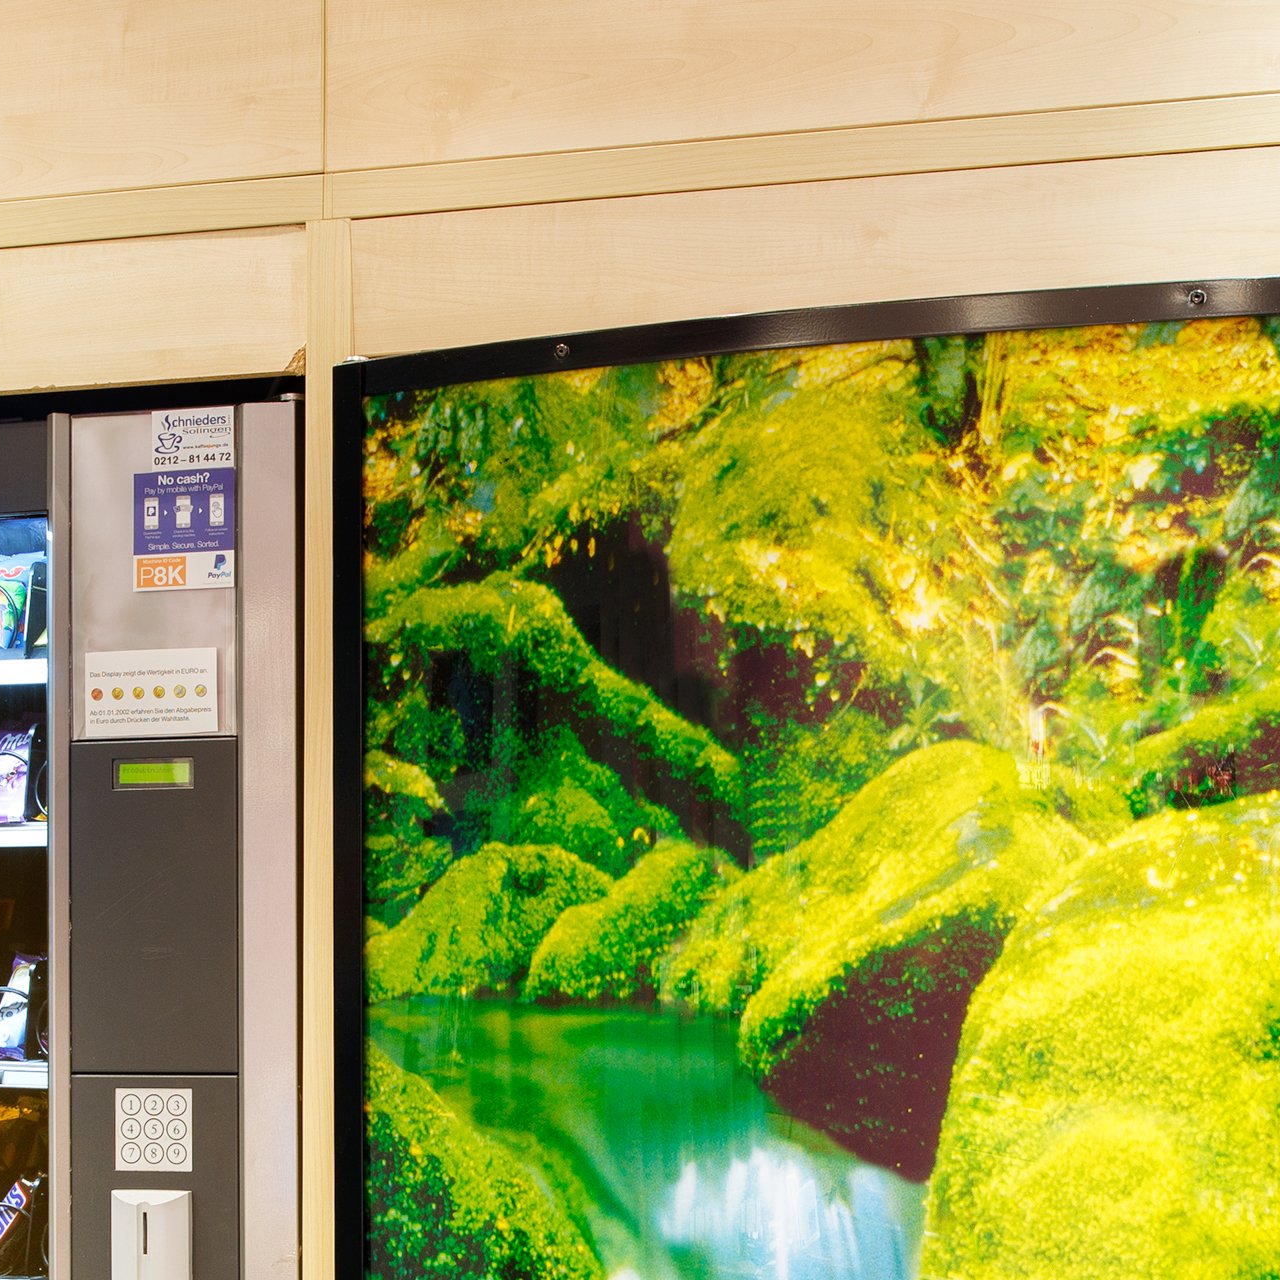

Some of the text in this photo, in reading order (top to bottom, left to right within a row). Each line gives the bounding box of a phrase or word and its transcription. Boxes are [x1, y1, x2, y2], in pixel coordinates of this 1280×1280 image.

[165, 414, 226, 431] Schnieders
[182, 426, 231, 434] Solingen
[154, 456, 178, 465] 0212
[189, 454, 200, 464] 81
[204, 453, 216, 462] 44
[219, 452, 231, 460] 72
[158, 472, 210, 486] No cash?
[166, 485, 187, 493] mobile
[188, 484, 201, 492] with
[202, 483, 224, 492] PayPal
[148, 540, 220, 551] Simple. Secure. Sorted.
[140, 565, 184, 587] P8K
[208, 571, 231, 579] PayPal
